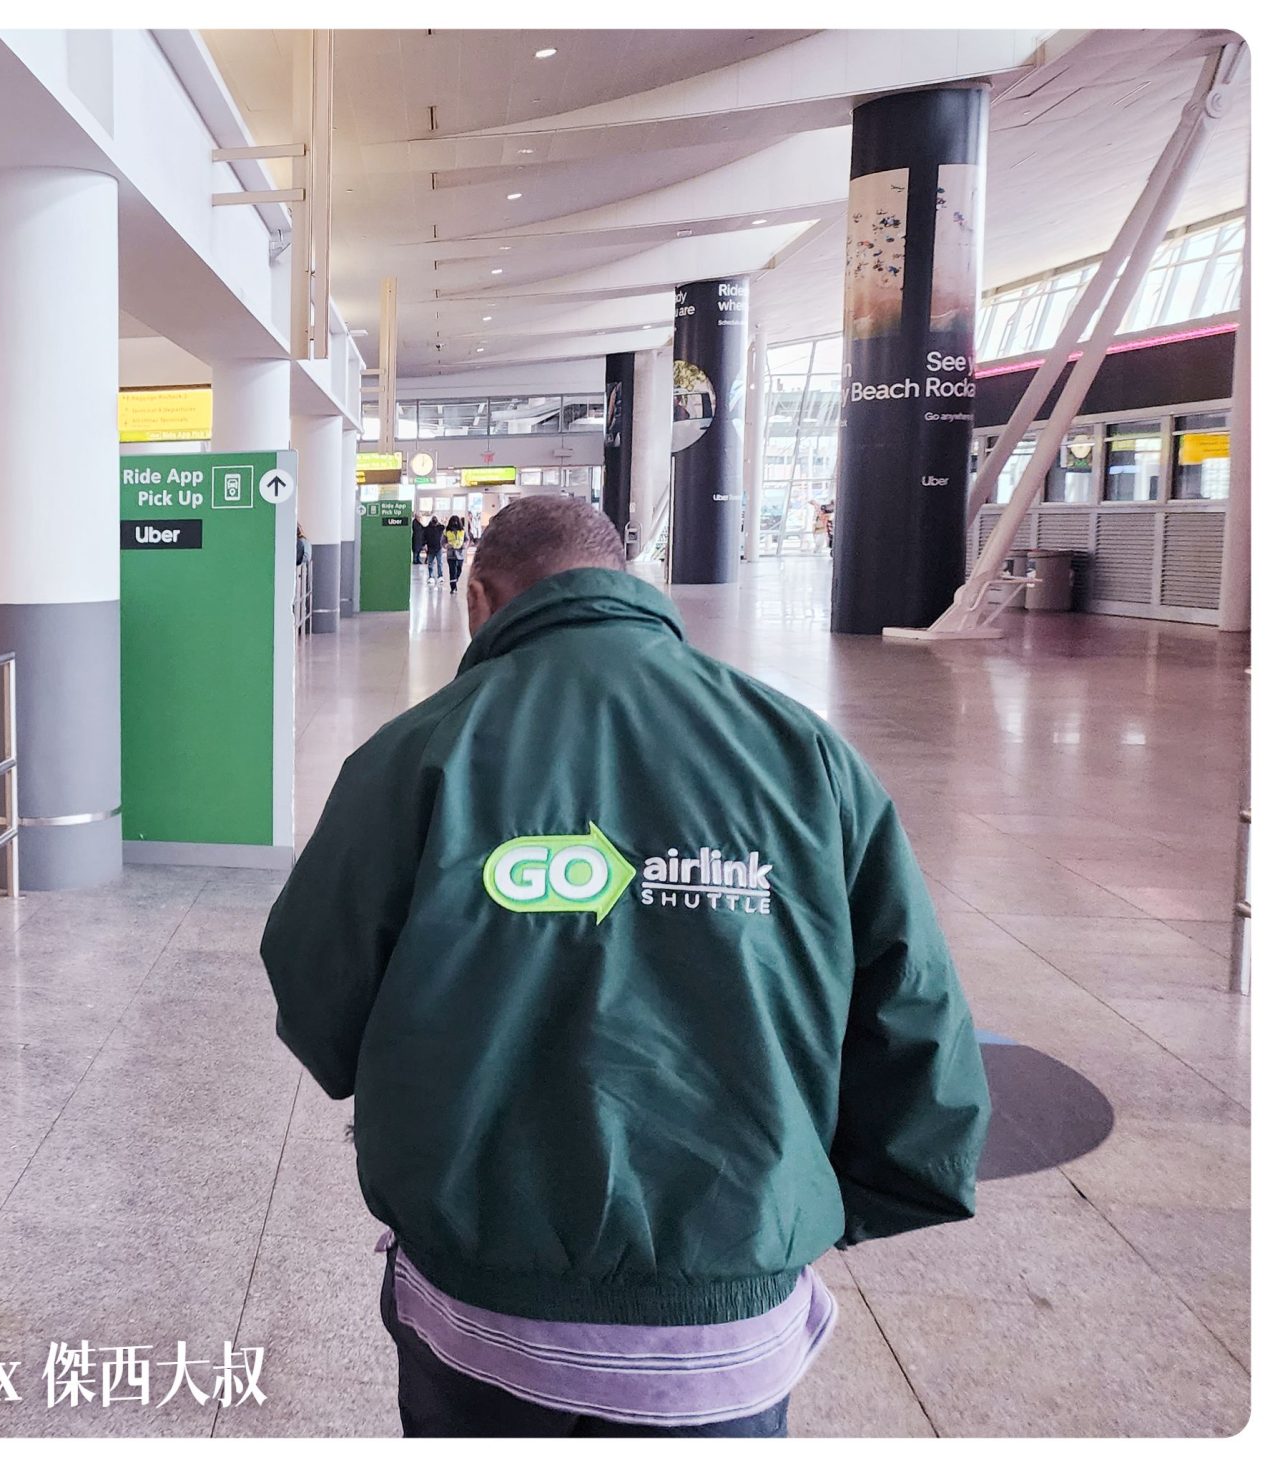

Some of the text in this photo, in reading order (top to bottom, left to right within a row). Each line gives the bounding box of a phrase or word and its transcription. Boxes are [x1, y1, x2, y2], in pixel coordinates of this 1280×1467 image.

[926, 351, 966, 372] See
[851, 379, 920, 402] Beach
[925, 377, 976, 398] Rocka
[924, 412, 939, 421] Go
[123, 468, 204, 487] Ride App
[922, 475, 949, 487] Uber
[138, 490, 204, 509] Pick Up
[135, 526, 180, 544] Uber
[494, 845, 773, 902] GO airlink
[641, 888, 771, 914] SHUTTLE
